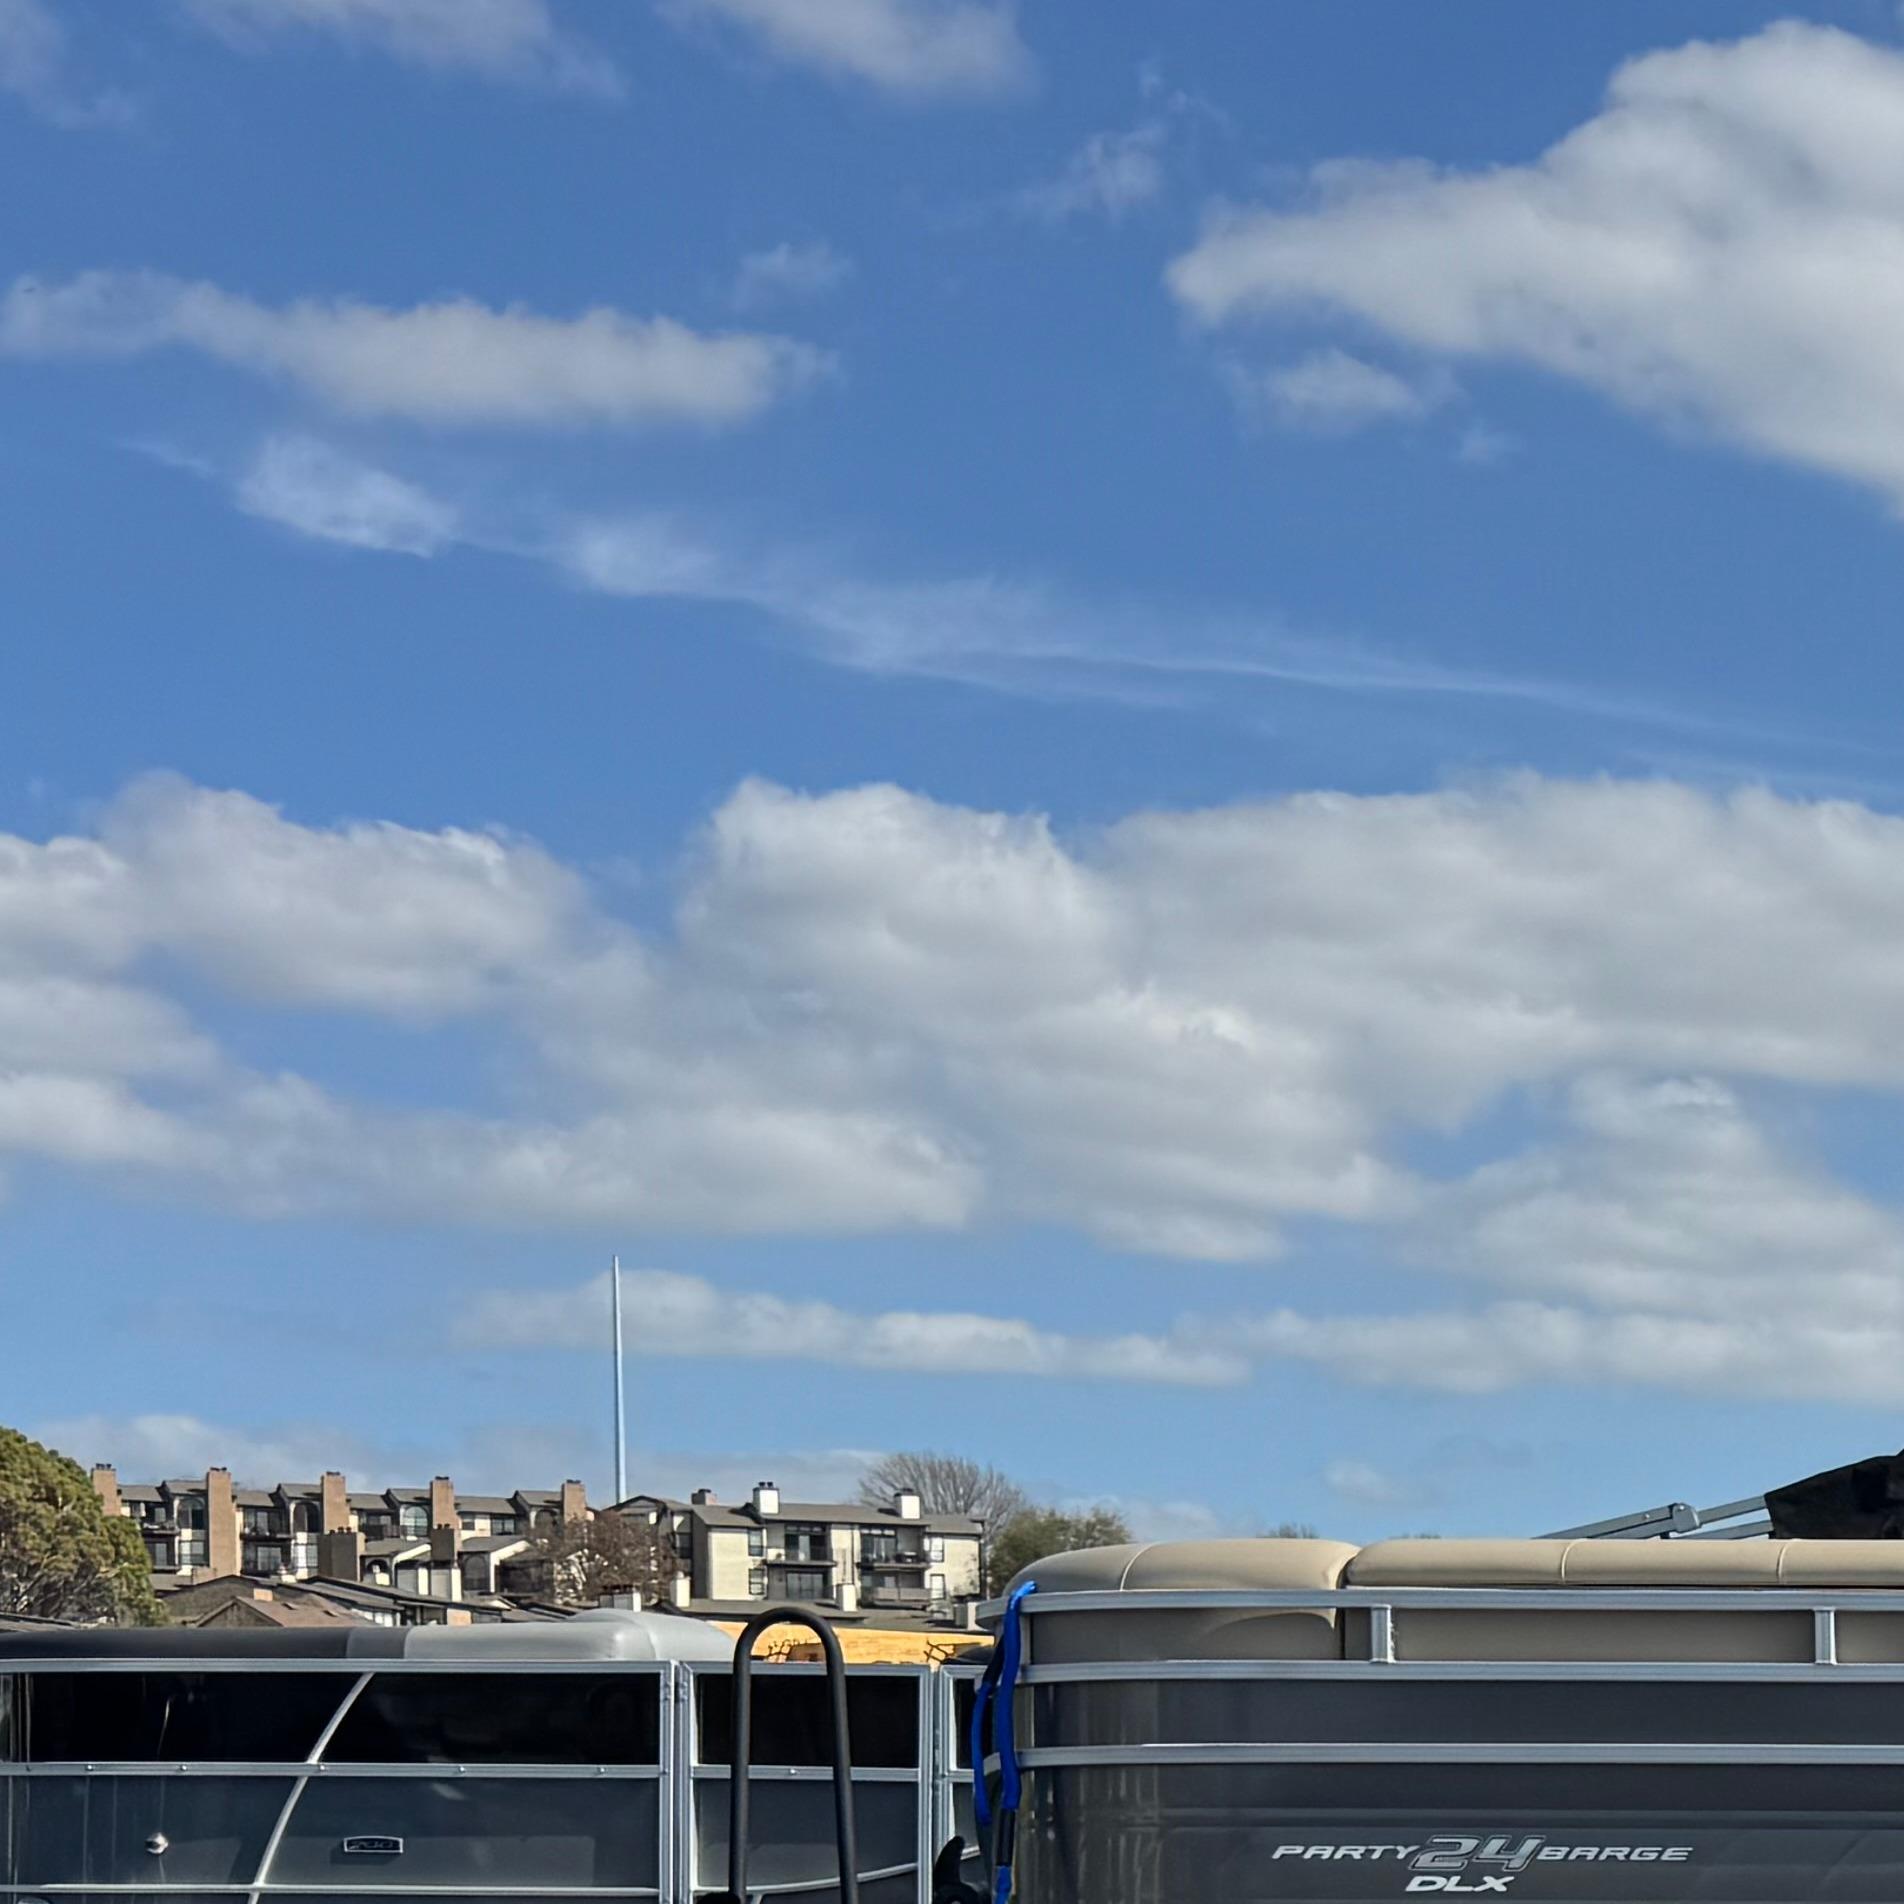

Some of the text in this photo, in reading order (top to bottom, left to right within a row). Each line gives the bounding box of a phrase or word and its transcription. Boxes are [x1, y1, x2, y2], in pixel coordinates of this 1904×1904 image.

[1271, 1834, 1694, 1872] PARTY 24 BARGE
[1404, 1875, 1515, 1892] DLX
